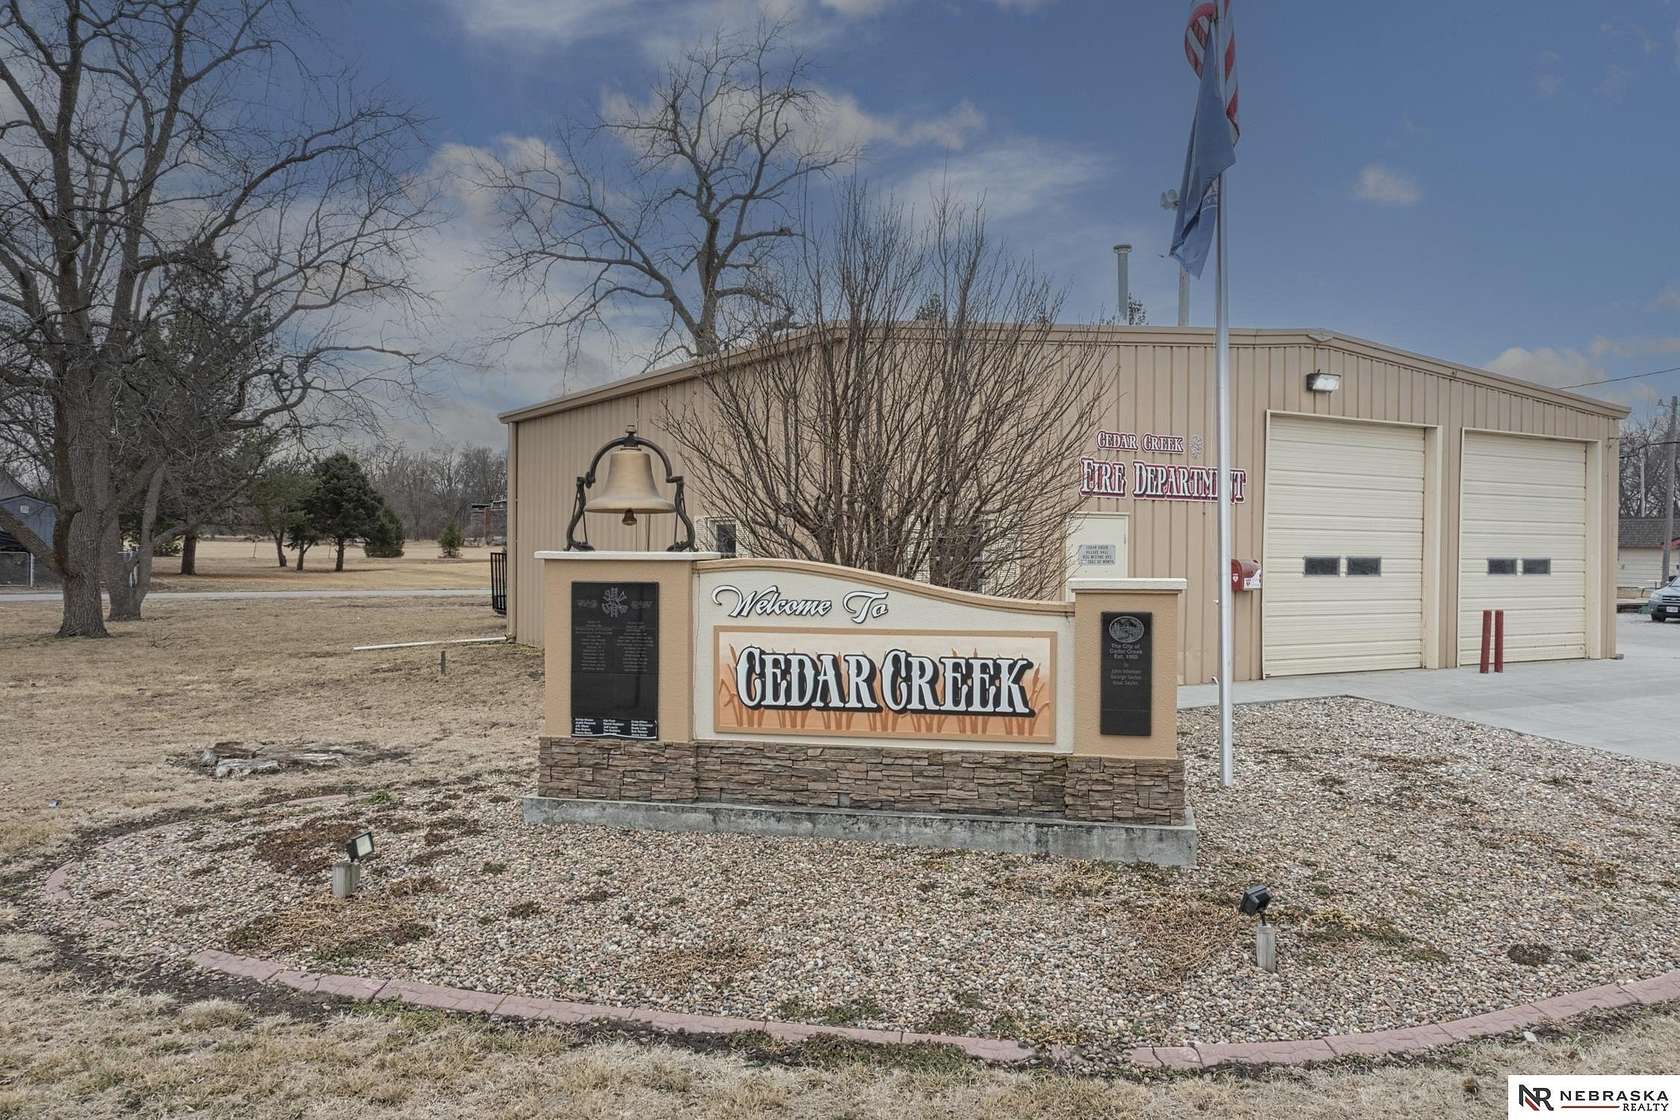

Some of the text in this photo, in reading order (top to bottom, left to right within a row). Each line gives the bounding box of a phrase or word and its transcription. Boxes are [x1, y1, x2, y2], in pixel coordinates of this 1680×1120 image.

[1097, 431, 1184, 454] CEDAR CREEK
[1080, 457, 1247, 503] FIRE DEPARTMT
[712, 584, 889, 624] Welcome To
[735, 645, 883, 712] CEDAR
[880, 648, 1036, 718] CREEK
